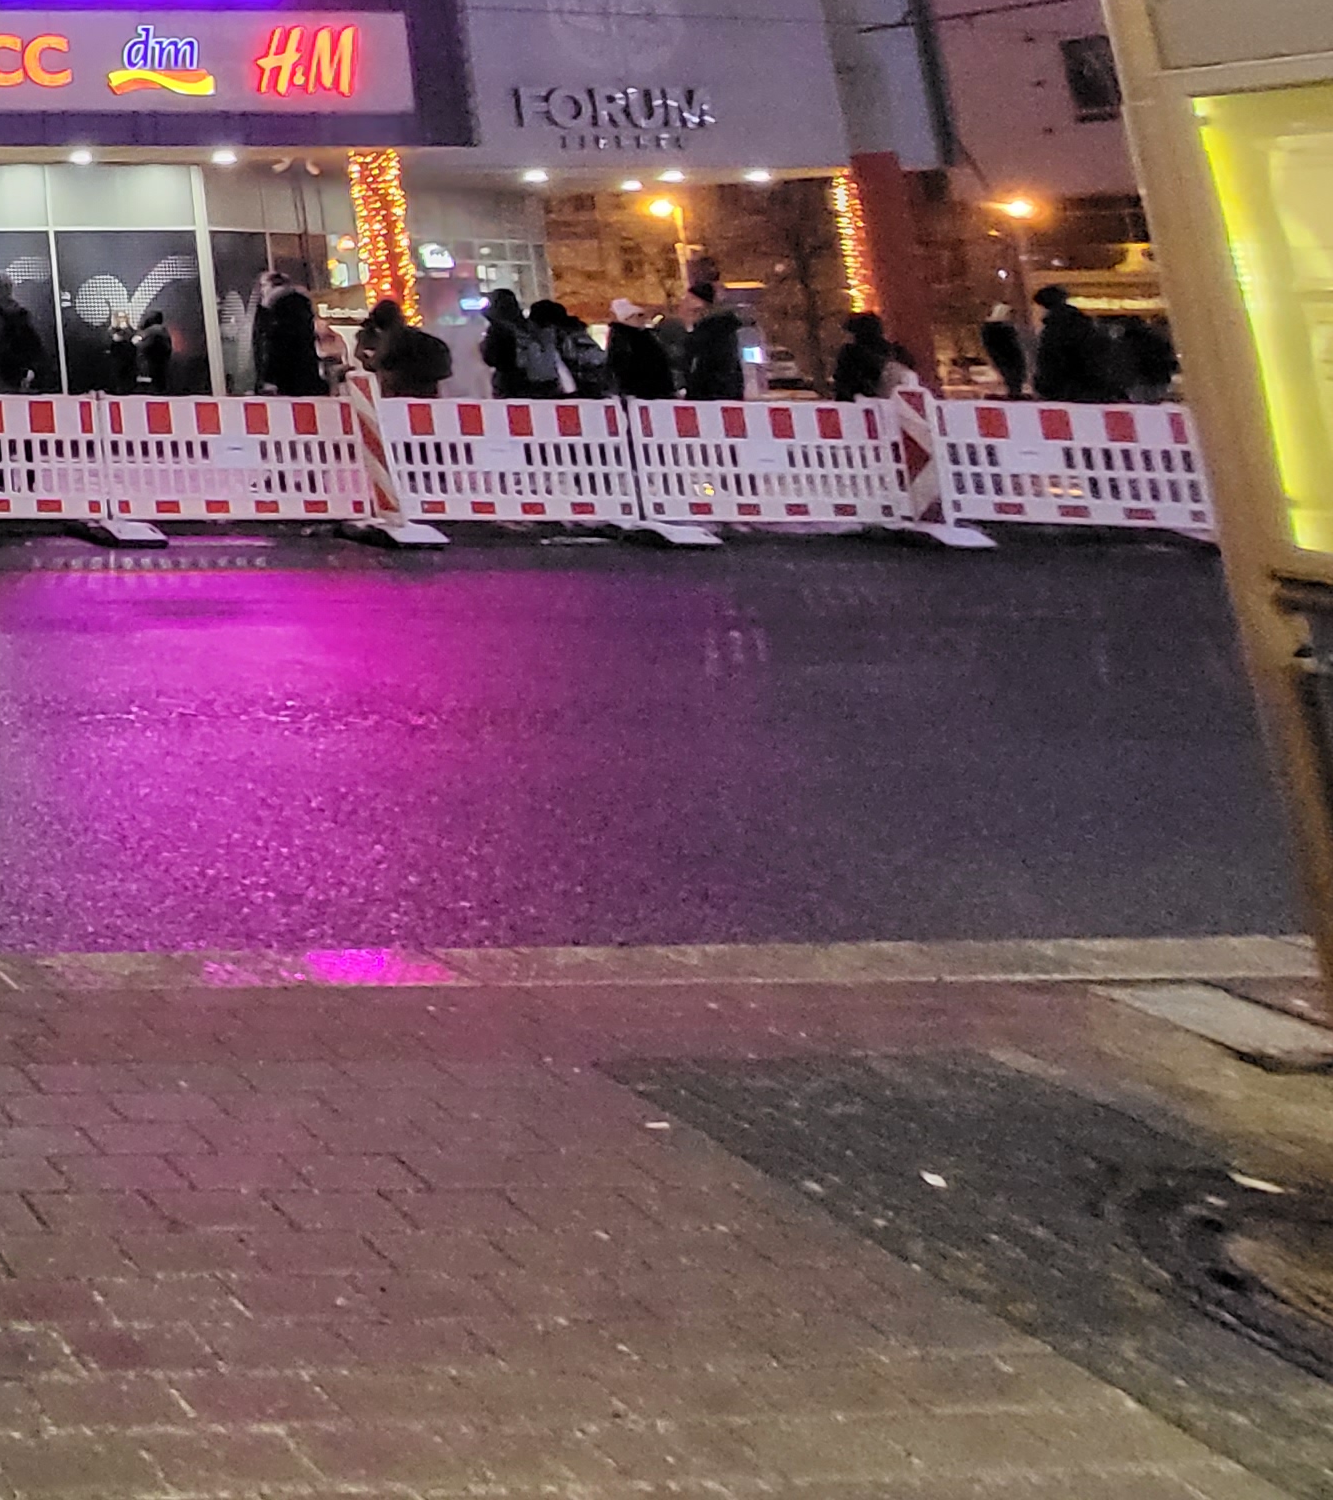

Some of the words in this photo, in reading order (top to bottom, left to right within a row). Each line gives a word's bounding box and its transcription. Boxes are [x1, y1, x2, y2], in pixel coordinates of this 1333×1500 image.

[122, 25, 200, 70] dm
[254, 25, 359, 98] H&M
[511, 85, 717, 130] FORUM
